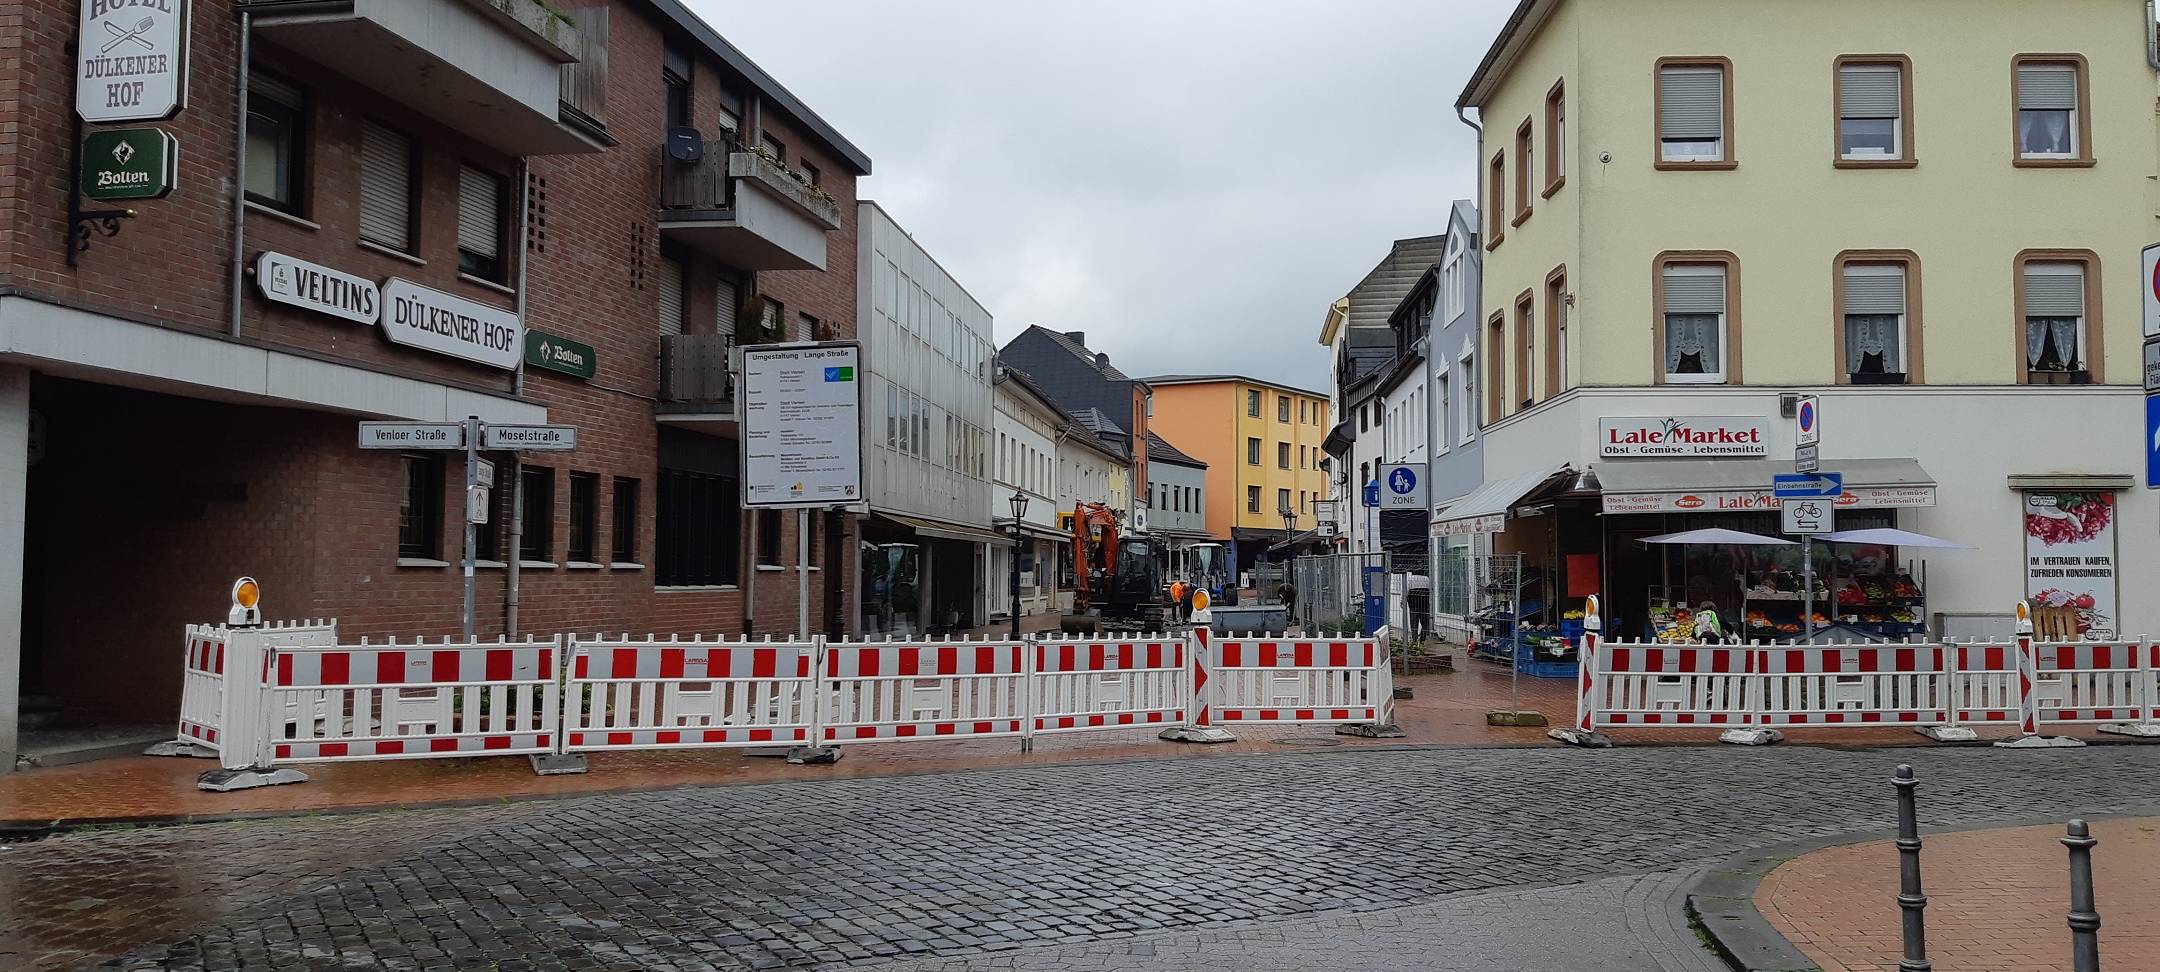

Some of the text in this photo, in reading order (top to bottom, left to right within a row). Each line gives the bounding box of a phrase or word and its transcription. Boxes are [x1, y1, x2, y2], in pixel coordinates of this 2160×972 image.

[84, 54, 168, 79] DÜLKENER
[106, 81, 144, 107] HOF
[97, 170, 149, 186] Bolten
[294, 266, 374, 317] VELTINS
[394, 294, 515, 353] DÜLKENER HOF
[554, 344, 584, 366] Bolten
[752, 350, 849, 362] Umgestaltung Lange Straße
[375, 428, 447, 441] Venloer Straße
[499, 429, 560, 442] Moselstraße
[1609, 427, 1760, 444] Lale Market
[1801, 432, 1814, 443] ZONE
[1604, 446, 1630, 454] Obst
[1640, 445, 1684, 454] Gemüse
[1694, 445, 1765, 454] Lebensmittel
[1871, 490, 1890, 498] Obst
[1896, 489, 1928, 497] Gemüse
[1392, 496, 1415, 505] ZONE
[1719, 496, 1753, 508] Lale
[1874, 497, 1927, 505] Lebensmittel
[2030, 556, 2112, 567] IM VERTRAUEN KAUFEN,
[2030, 568, 2112, 578] ZUFRIEDEN KONSUMIEREN
